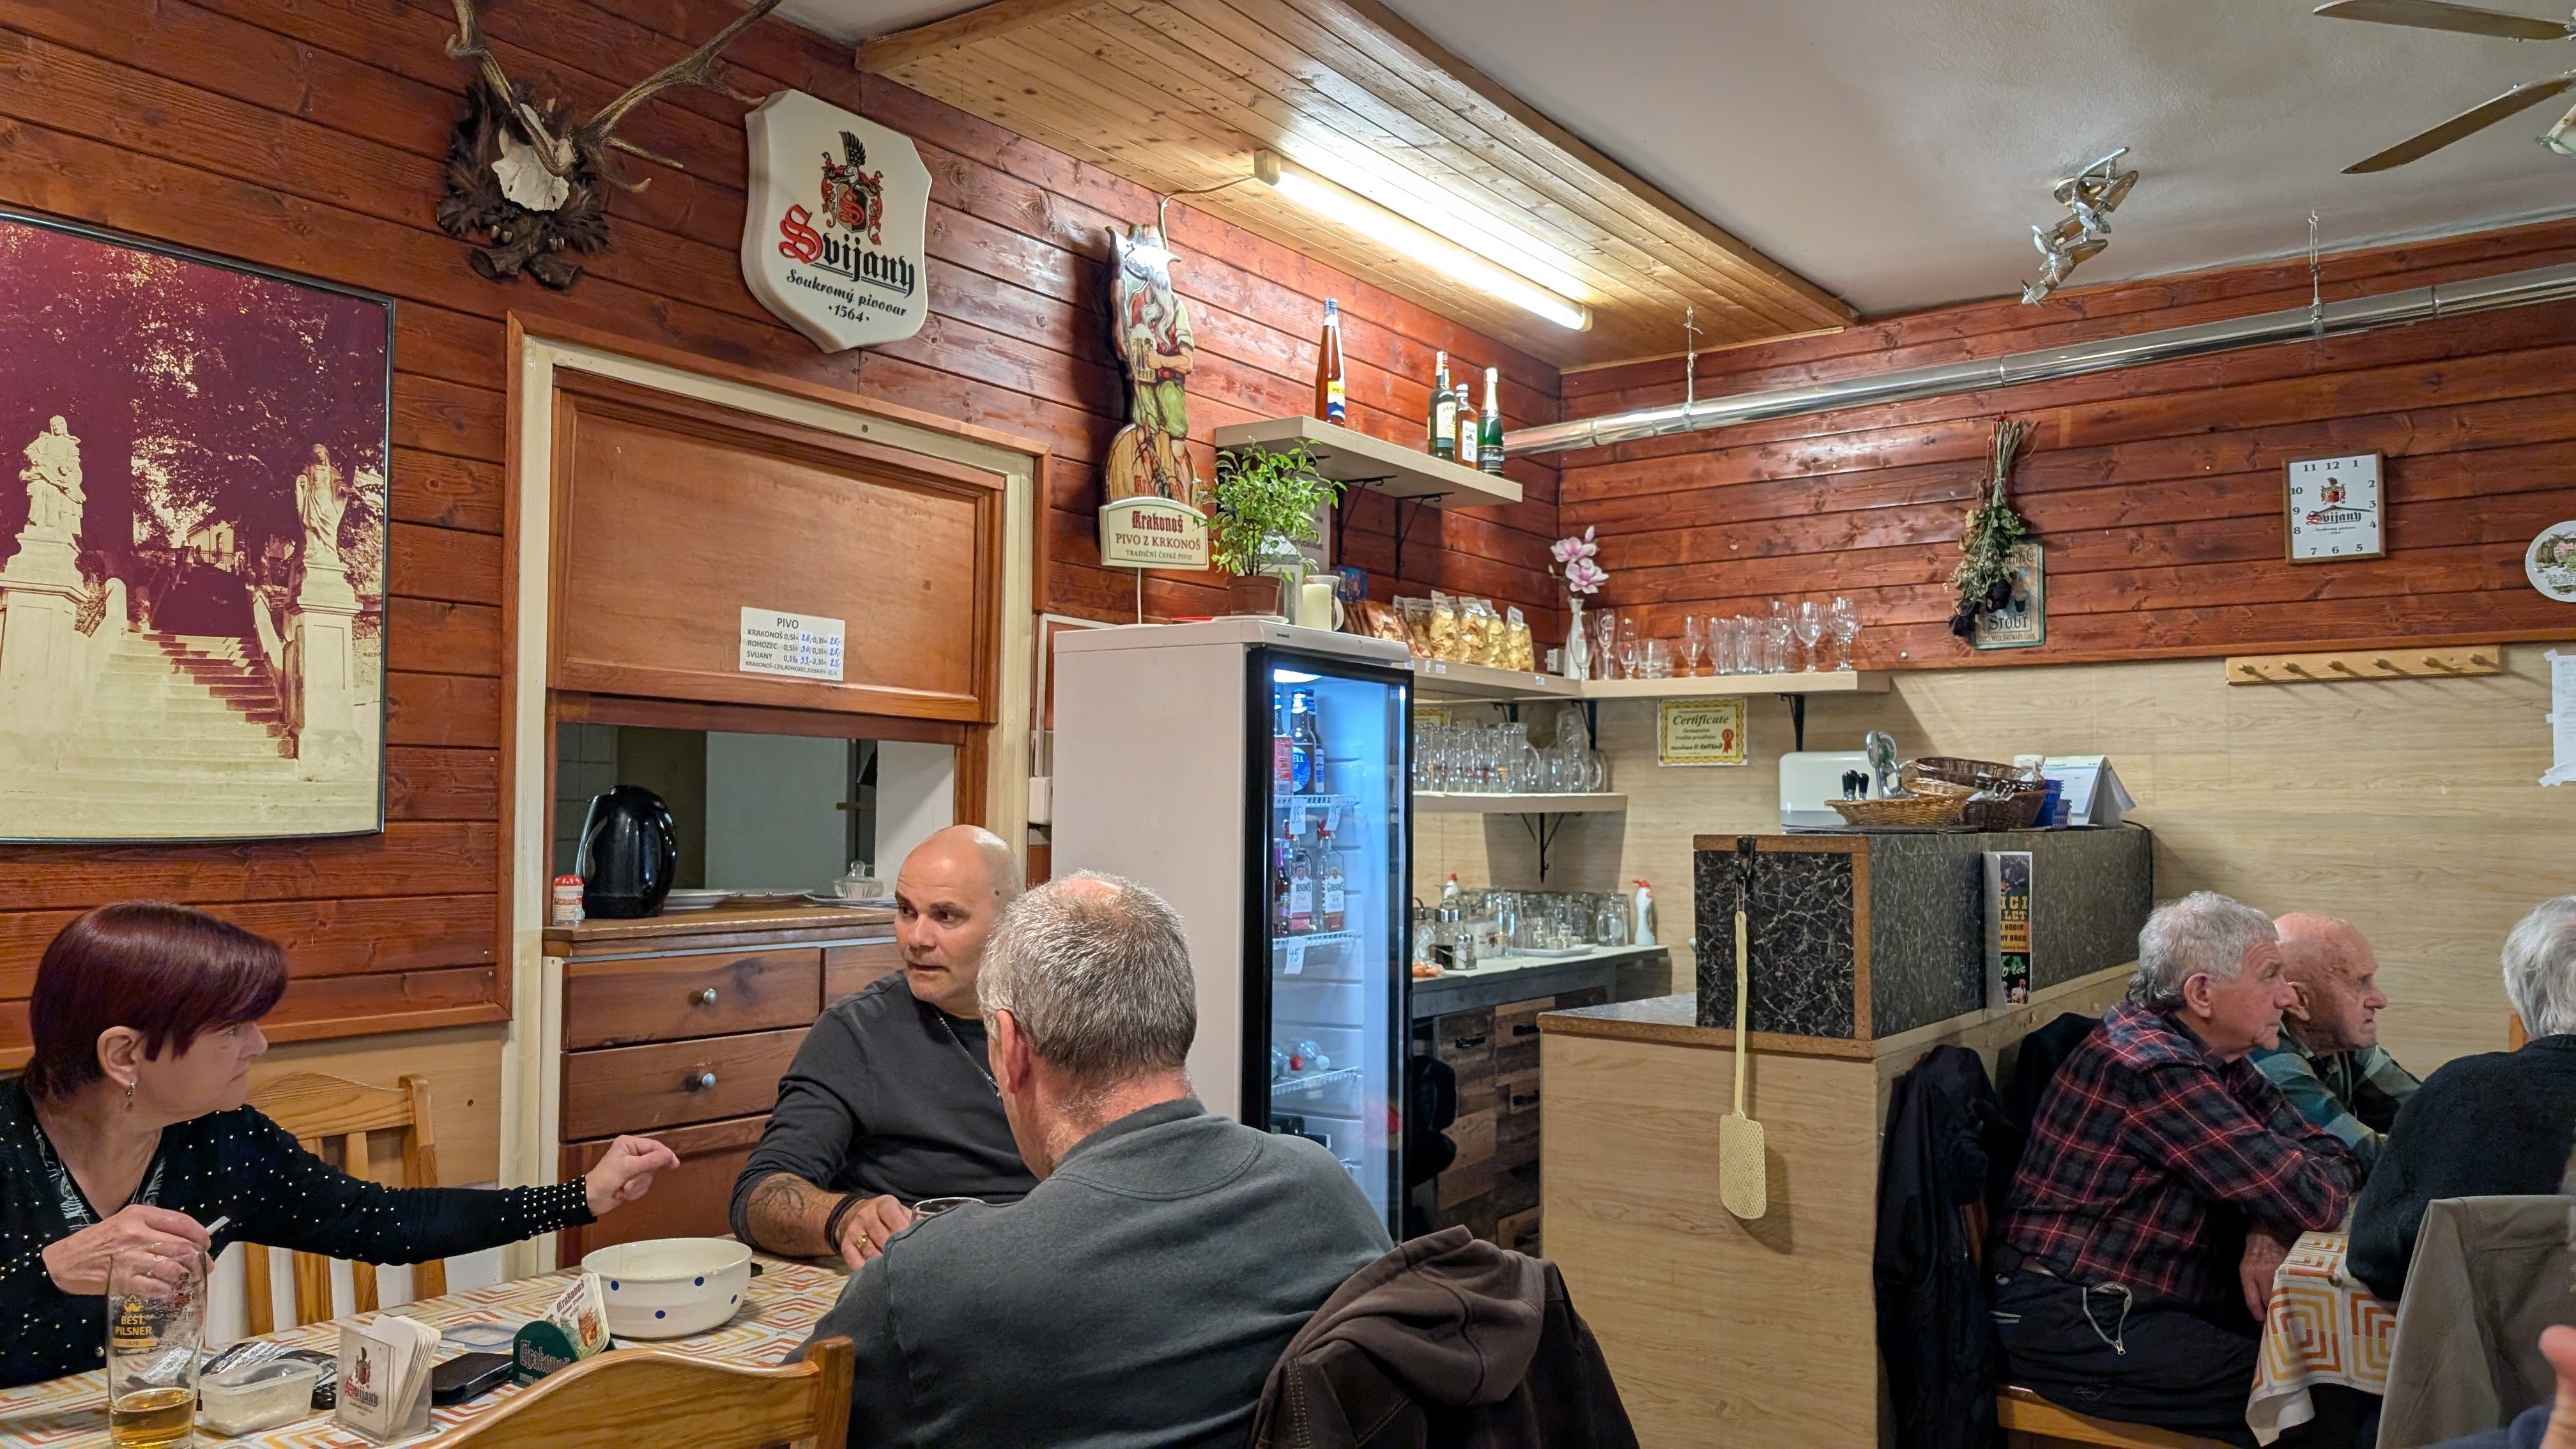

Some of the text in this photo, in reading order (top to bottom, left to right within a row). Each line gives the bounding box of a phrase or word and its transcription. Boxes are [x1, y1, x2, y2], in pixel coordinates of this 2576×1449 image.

[778, 204, 915, 298] Svijany
[786, 269, 907, 316] Soukromý pivovar
[2326, 461, 2340, 470] 12
[2352, 459, 2359, 468] 1
[2290, 487, 2303, 495] 10
[1132, 510, 1183, 533] Krakonoš
[2306, 510, 2362, 525] Svijany
[2370, 520, 2377, 528] 4
[2294, 526, 2301, 535] 8
[1116, 533, 1201, 550] PIVO Z KRKONOŠ
[2356, 544, 2363, 552] 5
[1126, 549, 1192, 560] TRADIČNÍ ČESKÉ PIVO
[777, 618, 799, 629] PIVO
[747, 629, 783, 639] KRAKONOŠ
[747, 640, 778, 649] ROHOZEC
[747, 650, 772, 659] SVIJANY
[1673, 714, 1729, 727] Certificate
[2004, 910, 2027, 920] LET
[121, 1315, 144, 1324] BEST
[116, 1326, 152, 1335] PILSNER
[344, 1375, 378, 1407] Svijany
